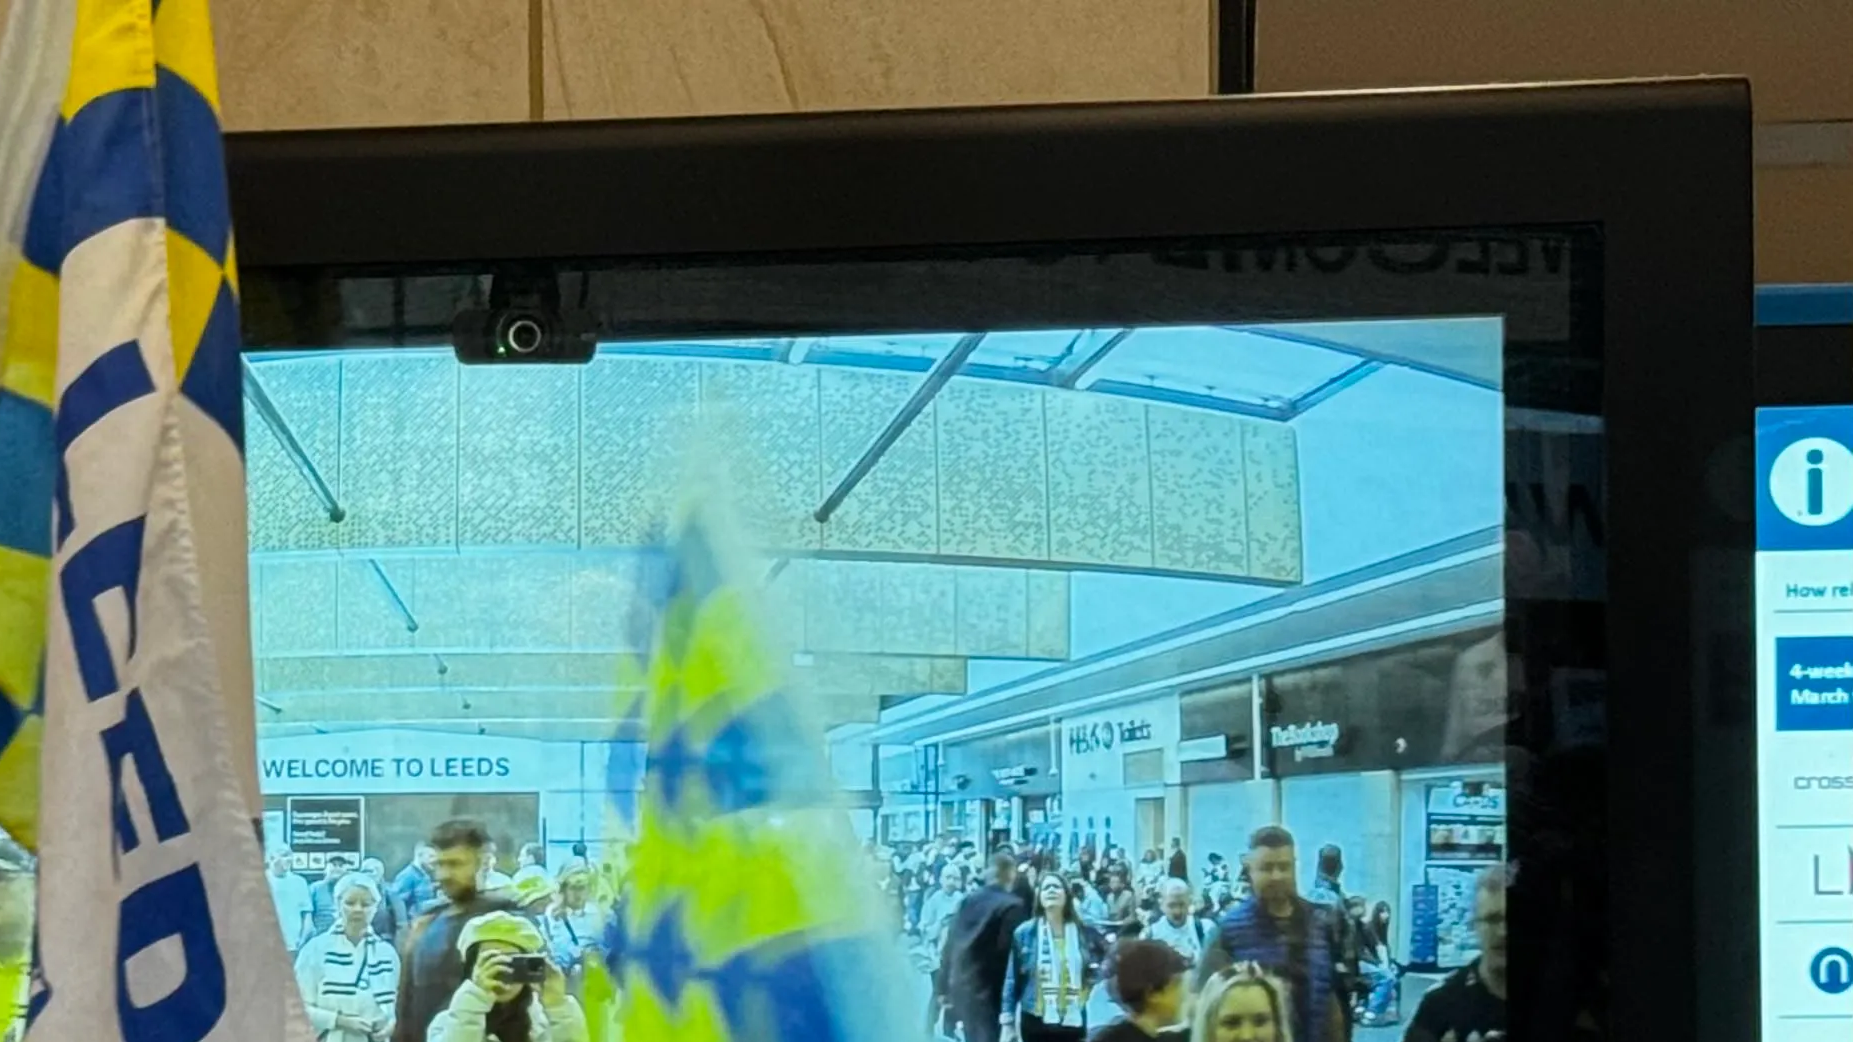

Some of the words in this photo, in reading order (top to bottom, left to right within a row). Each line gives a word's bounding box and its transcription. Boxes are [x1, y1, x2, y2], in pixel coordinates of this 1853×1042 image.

[1786, 583, 1828, 598] How
[1790, 687, 1849, 705] March
[263, 758, 385, 778] WELCOME
[394, 758, 424, 777] TO
[430, 757, 511, 777] LEEDS
